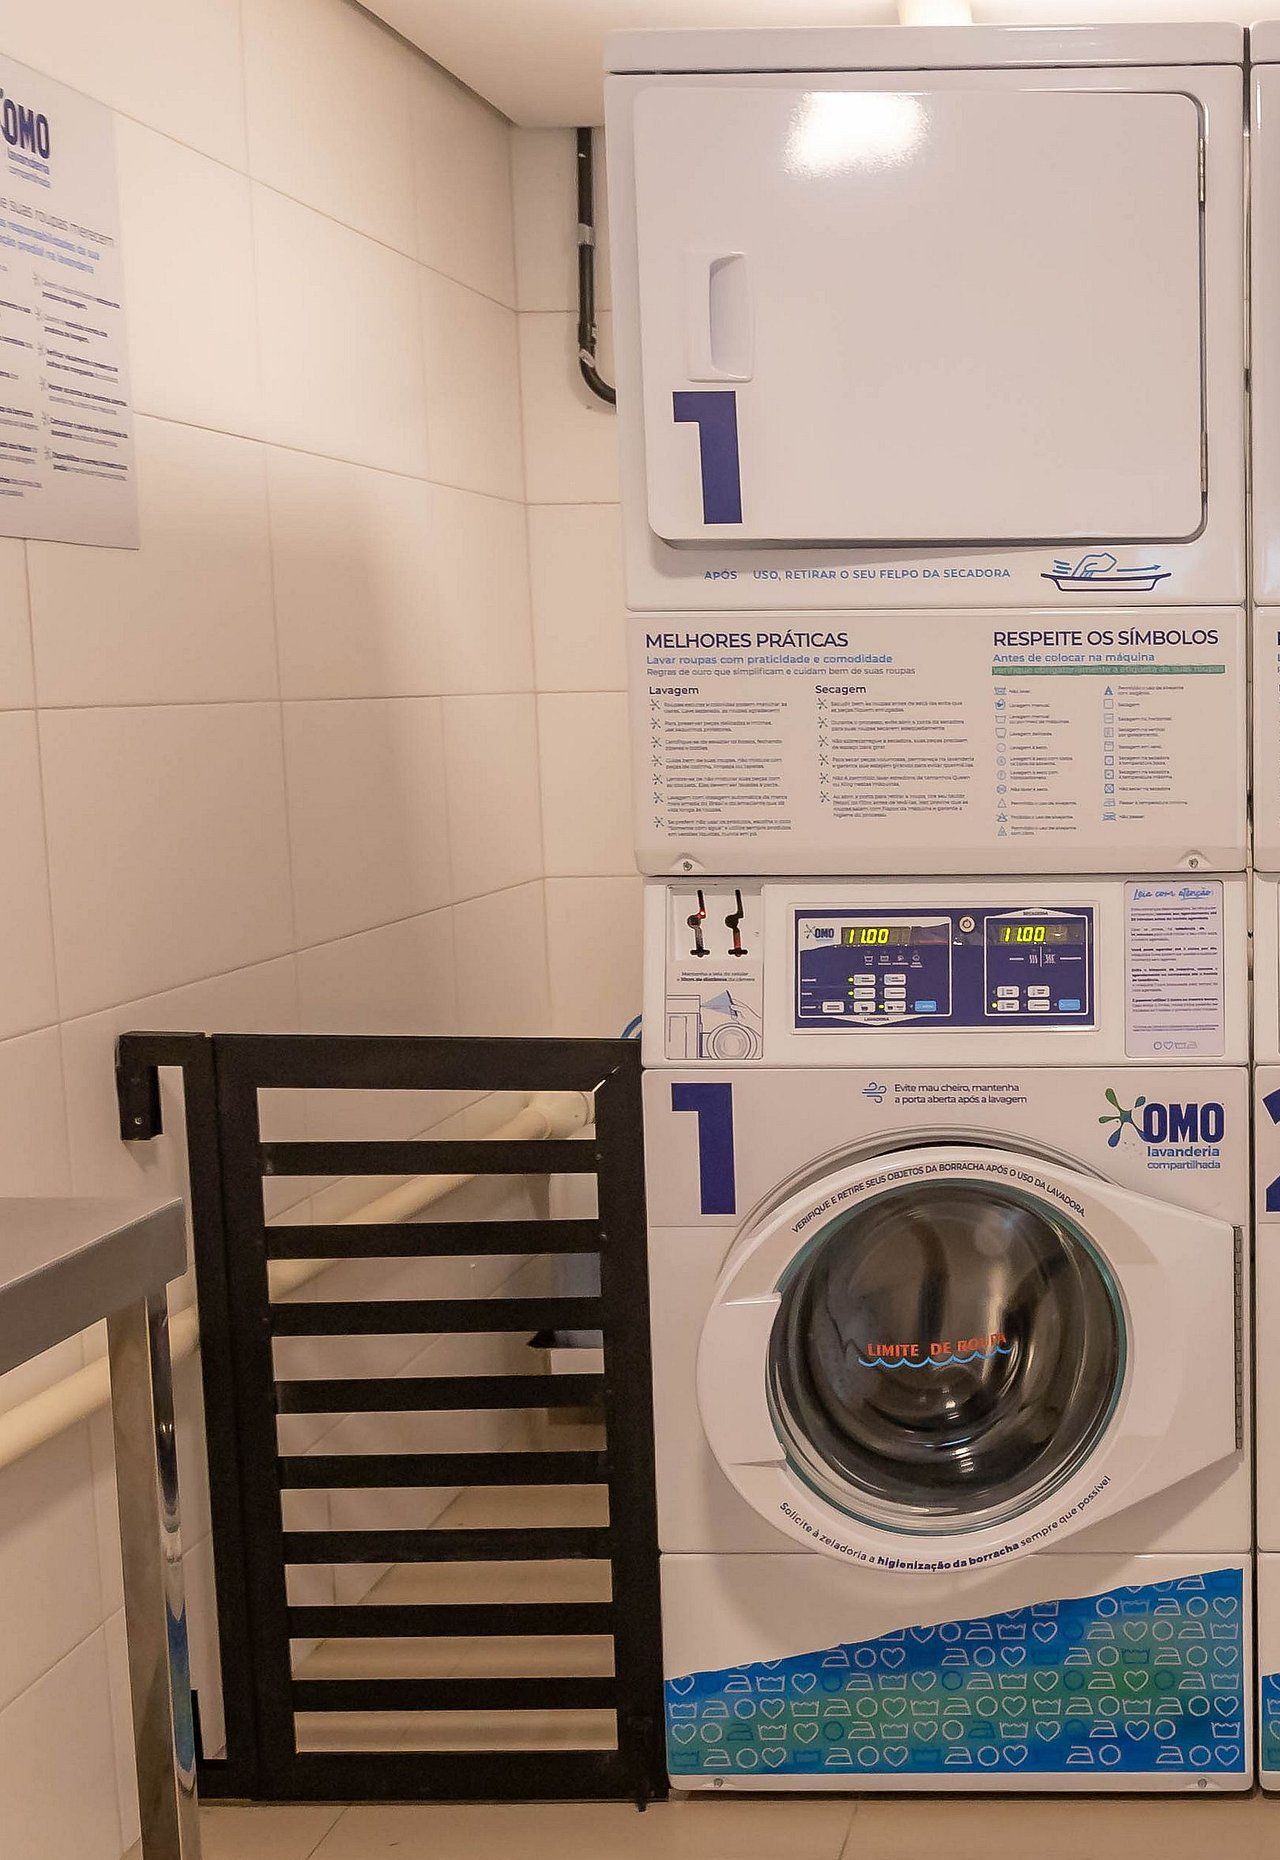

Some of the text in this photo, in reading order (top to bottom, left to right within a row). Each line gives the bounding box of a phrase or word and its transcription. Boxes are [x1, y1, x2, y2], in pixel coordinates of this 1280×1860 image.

[3, 98, 50, 159] OMO
[673, 391, 742, 525] 1
[753, 570, 781, 581] USO,
[785, 570, 836, 579] RETIRAR
[840, 570, 849, 579] O
[853, 570, 876, 578] SEU
[880, 570, 918, 579] FELPO
[923, 570, 940, 578] DA
[944, 569, 1011, 578] SECADORA
[646, 629, 848, 648] MELHORES PRÁTICAS
[994, 627, 1218, 646] RESPEITE OS SÍMBOLOS
[647, 656, 676, 664] Lavar
[680, 657, 717, 666] roupas
[747, 655, 810, 665] praticidade
[823, 654, 893, 663] comodidade
[993, 654, 1025, 662] Antes
[1028, 653, 1041, 662] de
[1045, 653, 1085, 662] colocar
[1105, 652, 1155, 664] máquina
[647, 669, 676, 677] Regras
[714, 669, 730, 677] que
[733, 668, 784, 676] simplificam
[794, 667, 826, 675] cuidam
[829, 667, 848, 675] bem
[851, 667, 862, 675] de
[886, 668, 915, 676] roupas
[649, 686, 699, 697] Lavagem
[815, 685, 866, 696] Secagem
[1133, 889, 1152, 900] Leia
[815, 928, 834, 938] OMO
[849, 929, 889, 944] 11.00
[1004, 927, 1045, 942] 11.00
[895, 1083, 916, 1092] Evite
[941, 1083, 970, 1094] cheiro,
[972, 1084, 1019, 1092] mantenha
[902, 1097, 925, 1105] porta
[927, 1095, 956, 1103] aberta
[958, 1095, 980, 1105] após
[989, 1095, 1027, 1105] lavagem
[1144, 1103, 1224, 1142] OMO
[671, 1083, 736, 1215] 1
[1148, 1145, 1219, 1157] lavanderia
[1147, 1160, 1220, 1171] compartilhada
[791, 1200, 831, 1233] VERIFIQUE
[832, 1196, 838, 1205] E
[837, 1183, 865, 1200] RETIRE
[865, 1175, 887, 1189] SEUS
[887, 1166, 924, 1181] OBJETOS
[925, 1165, 937, 1174] DA
[939, 1163, 985, 1171] BORRACHA
[986, 1164, 1008, 1176] APÓS
[1009, 1169, 1016, 1177] O
[1017, 1172, 1034, 1183] USO
[1034, 1178, 1046, 1190] DA
[867, 1343, 919, 1357] LIMITE
[930, 1342, 951, 1356] DE
[780, 1502, 812, 1533] Solicite
[812, 1529, 819, 1538] à
[819, 1534, 867, 1561] zeladoria
[877, 1556, 950, 1572] higienização
[953, 1558, 967, 1568] da
[969, 1543, 1020, 1565] borracha
[1021, 1521, 1058, 1547] sempre
[1059, 1507, 1077, 1524] que
[1077, 1475, 1111, 1511] possível
